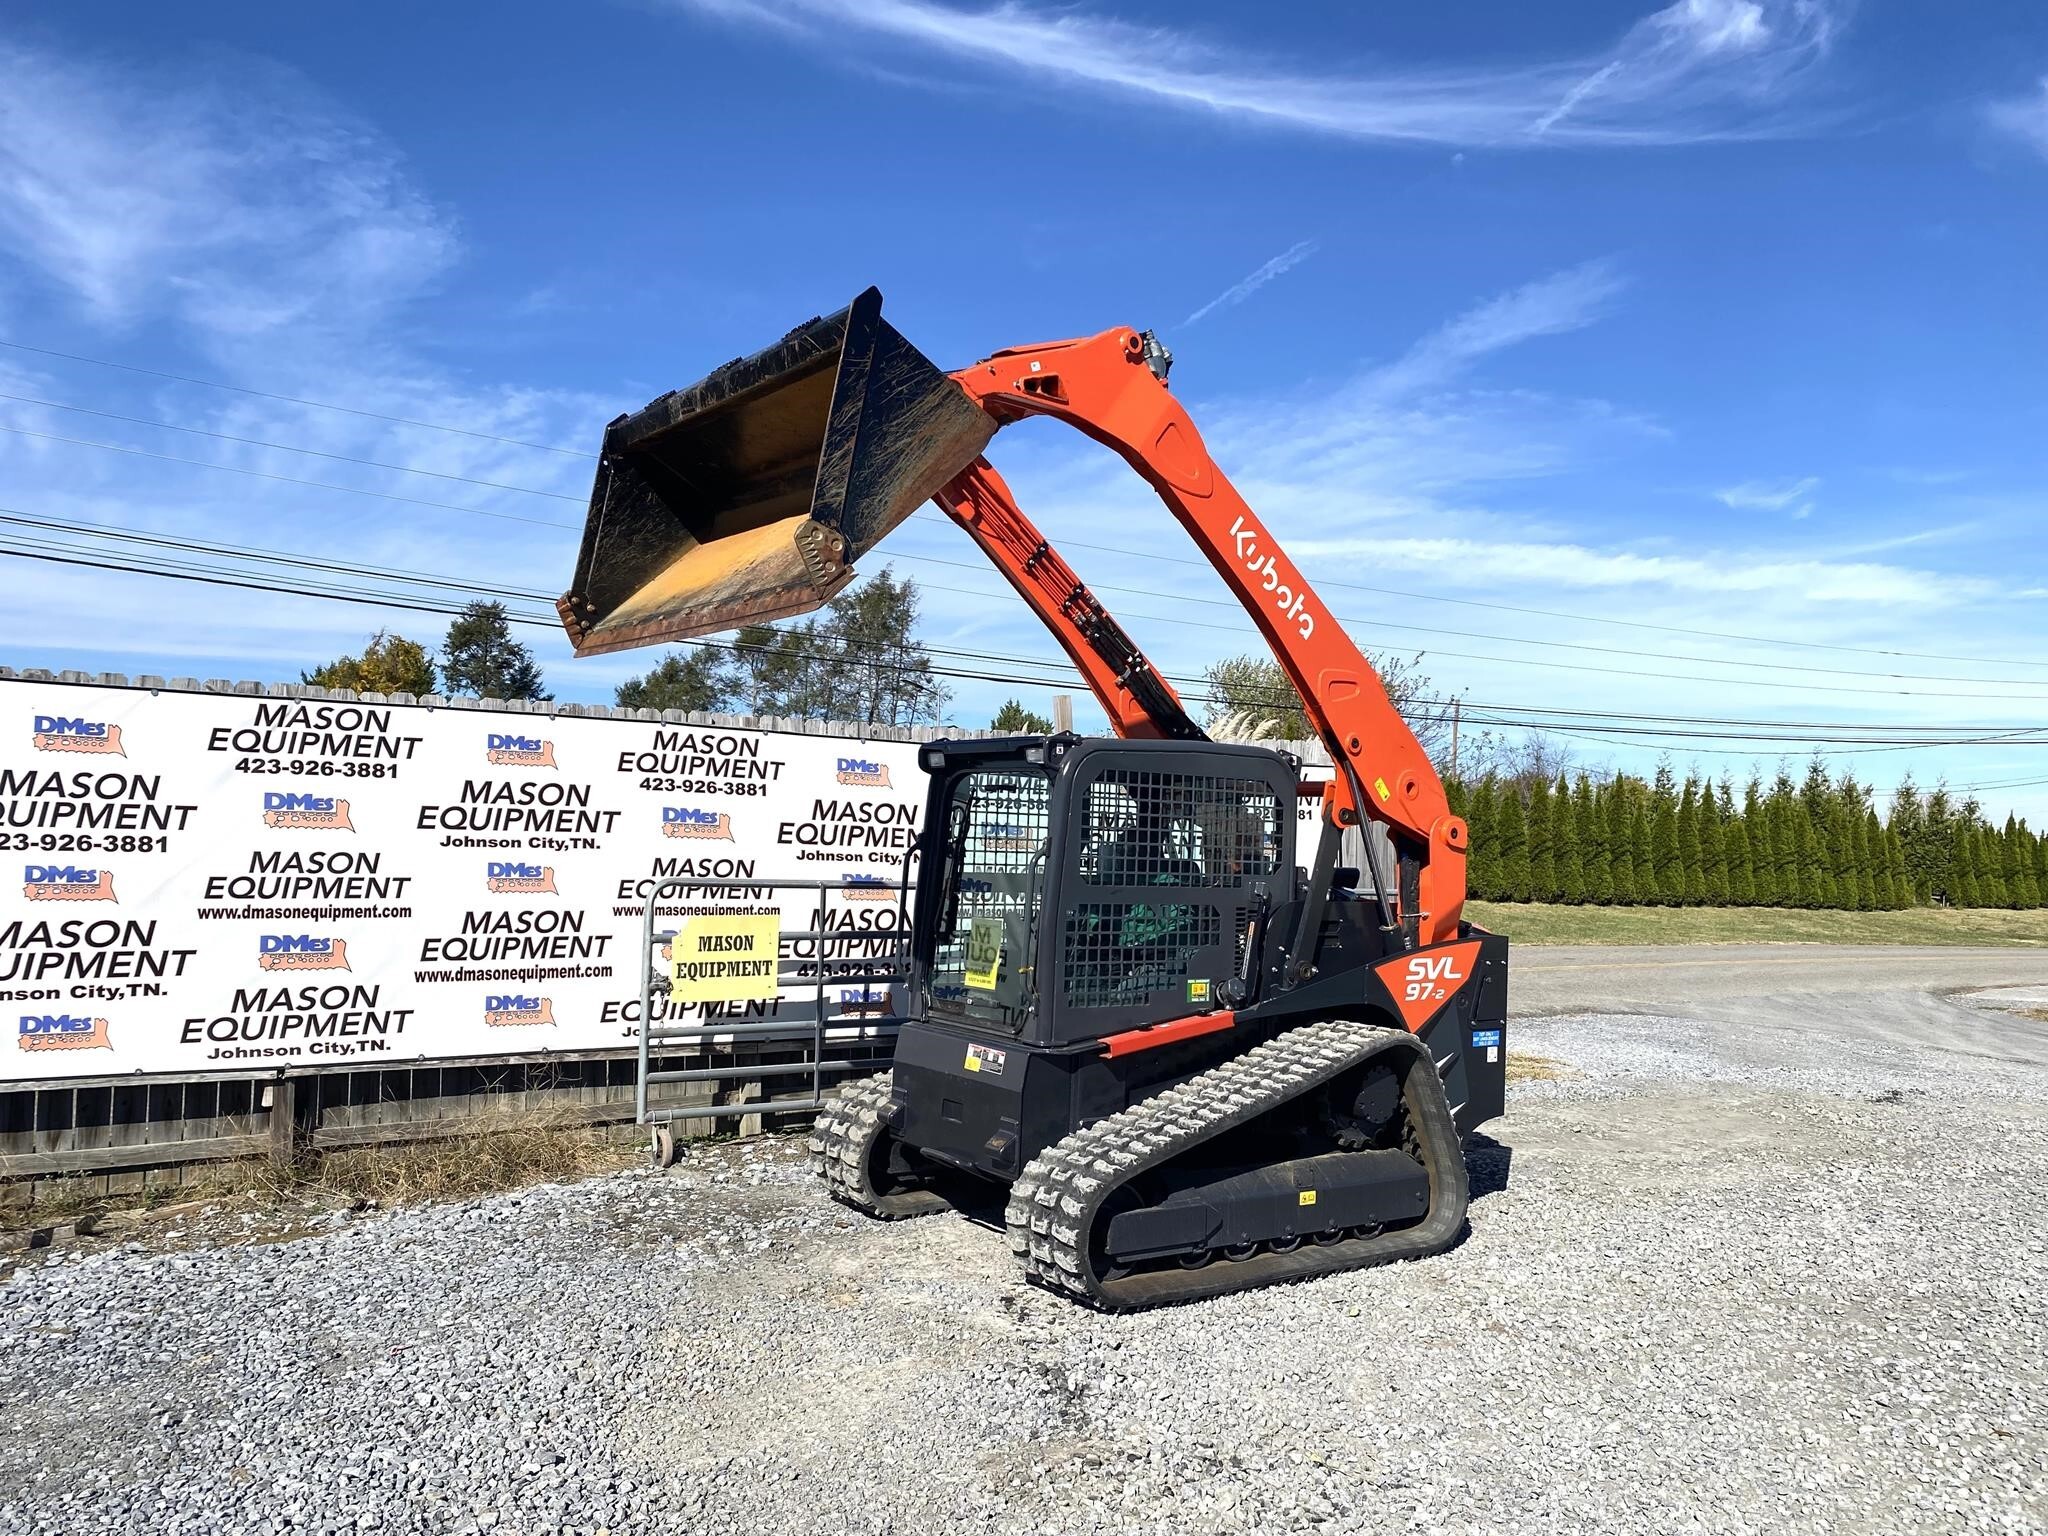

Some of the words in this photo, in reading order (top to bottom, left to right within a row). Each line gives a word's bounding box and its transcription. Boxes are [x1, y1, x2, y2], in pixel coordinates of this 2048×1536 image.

[1229, 515, 1315, 641] Kubota
[253, 703, 391, 733] MASON
[207, 727, 424, 760] EQUIPMENT
[652, 730, 760, 758] MASON
[234, 757, 397, 779] 423-926-3881
[617, 751, 786, 781] EQUIPMENT
[0, 769, 161, 801] MASON
[460, 779, 591, 807] MASON
[639, 777, 767, 797] 423-926-3881
[0, 801, 197, 830] UIPMENT
[416, 805, 622, 834] EQUIPMENT
[811, 799, 919, 826] MASON
[0, 832, 168, 853] 23-926-3881
[439, 835, 522, 848] Johnson
[528, 837, 601, 852] City,TN.
[777, 822, 920, 848] EQUIPMEN
[249, 851, 381, 875] MASON
[796, 849, 863, 862] Johnson
[651, 857, 755, 879] MASON
[204, 876, 412, 900] EQUIPMENT
[197, 903, 412, 923] www.dmasonequipment.com
[613, 904, 780, 916] wwwmasonequipment.com
[461, 910, 585, 935] MASON
[420, 935, 613, 962] EQUIPMENT
[697, 935, 754, 953] MASON
[777, 938, 912, 959] EQUIPME
[0, 950, 197, 981] UIPMENT
[414, 963, 613, 984] www.dmasonequipment.com
[676, 959, 773, 981] EQUIPMENT
[1405, 956, 1462, 981] SVL
[0, 989, 61, 1001] nson
[70, 983, 168, 1001] City,TN.
[230, 984, 380, 1014] MASON
[1405, 981, 1445, 1001] 97-2
[179, 1009, 415, 1044] EQUIPMENT
[207, 1046, 302, 1060] Johnson
[309, 1039, 391, 1056] City,TN.
